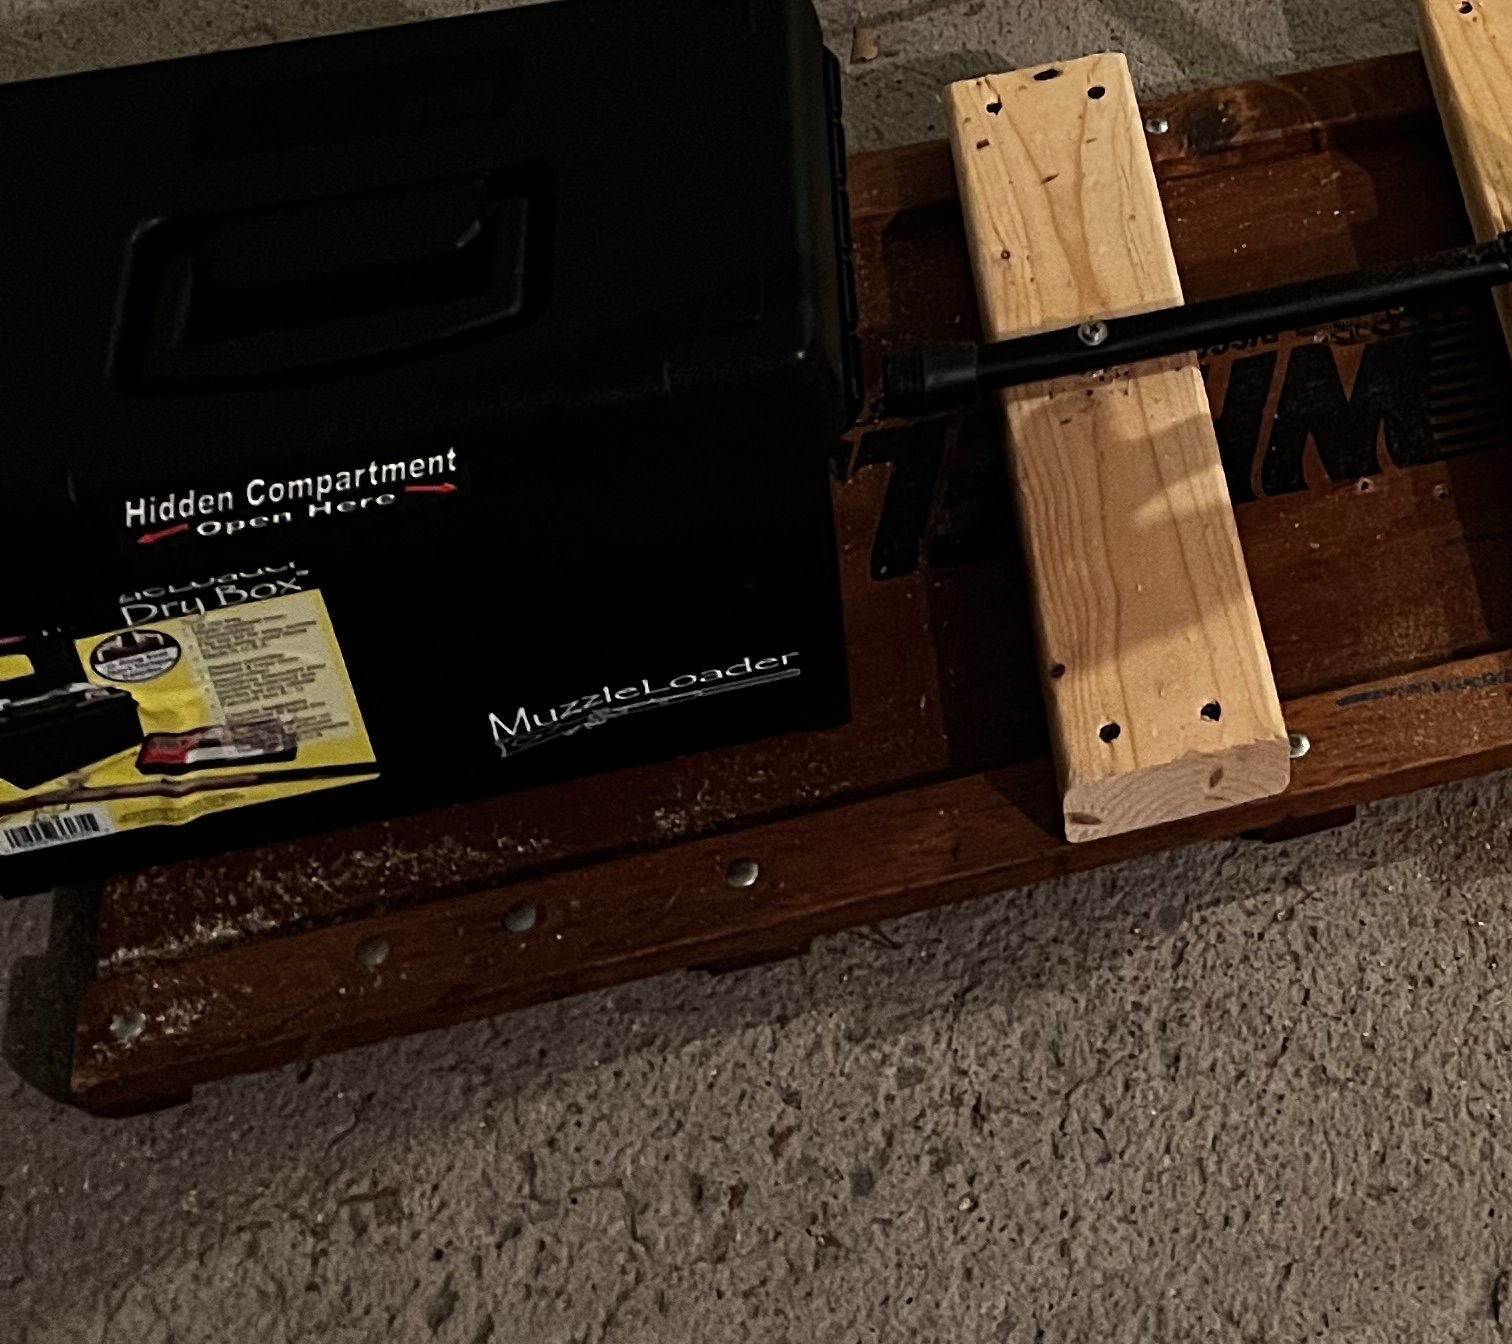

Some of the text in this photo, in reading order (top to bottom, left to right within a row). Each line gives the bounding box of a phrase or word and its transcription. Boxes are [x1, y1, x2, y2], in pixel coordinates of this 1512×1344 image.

[124, 446, 457, 528] Hidden Compartment
[196, 493, 396, 536] Open Here
[119, 597, 206, 627] Dry
[214, 577, 302, 606] Box
[488, 651, 800, 742] MuzzleLoader
